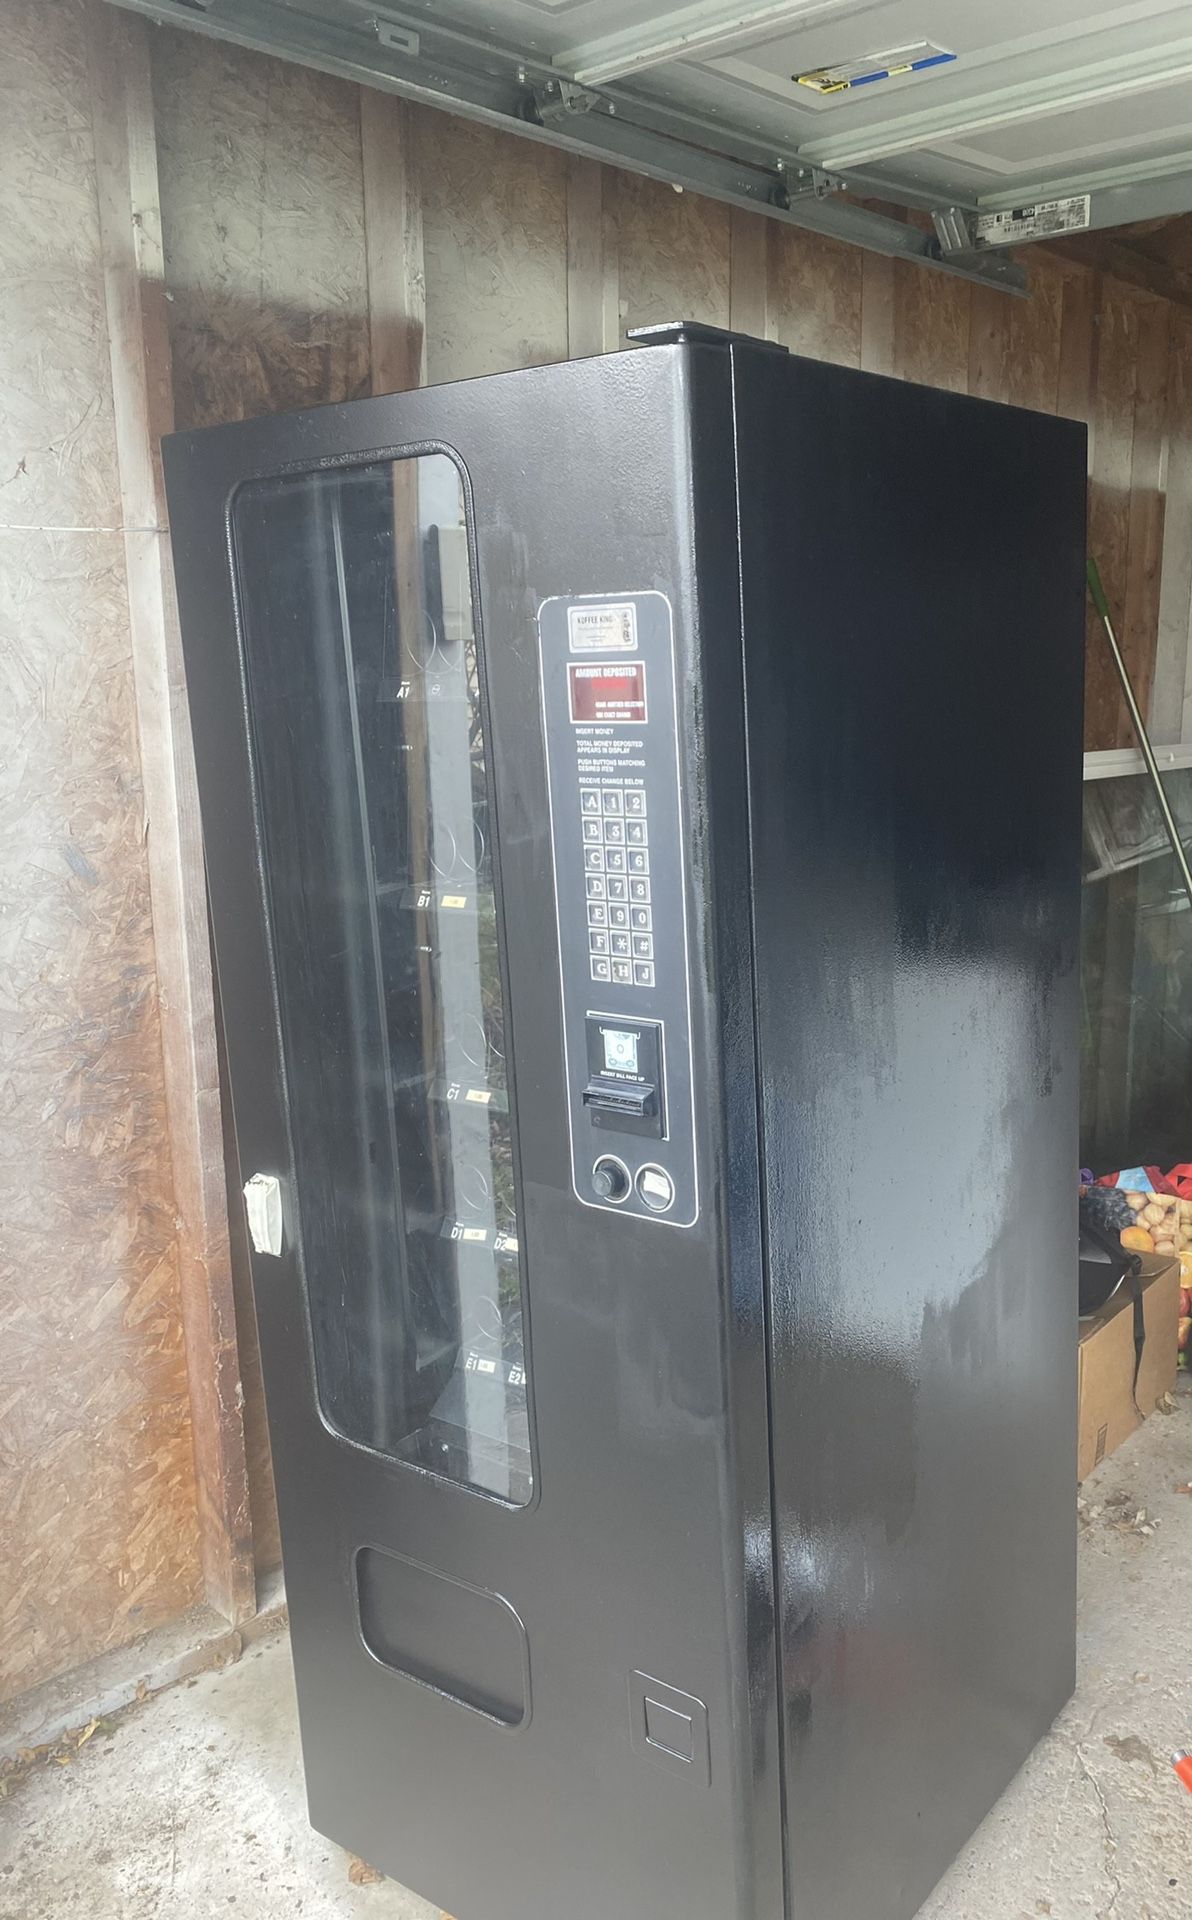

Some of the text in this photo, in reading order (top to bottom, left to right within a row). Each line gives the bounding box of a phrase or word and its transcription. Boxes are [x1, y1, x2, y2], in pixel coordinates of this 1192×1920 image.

[577, 615, 598, 625] KOFFEE
[576, 667, 637, 678] AMOUNT DEPOSITED
[396, 686, 410, 698] A1
[588, 795, 640, 809] A 1 2
[589, 824, 641, 838] B 3 4
[590, 852, 643, 867] C 5 6
[592, 880, 645, 895] D 7 8
[416, 895, 430, 908] B1
[594, 908, 604, 920] E
[616, 910, 624, 922] 9
[596, 935, 605, 947] F
[639, 940, 649, 951] #
[597, 963, 649, 979] G H J
[600, 1070, 615, 1078] INSERT
[446, 1088, 460, 1100] C1
[450, 1227, 463, 1240] D1
[493, 1237, 507, 1251] D2
[465, 1357, 477, 1371] E1
[508, 1370, 521, 1385] E2
